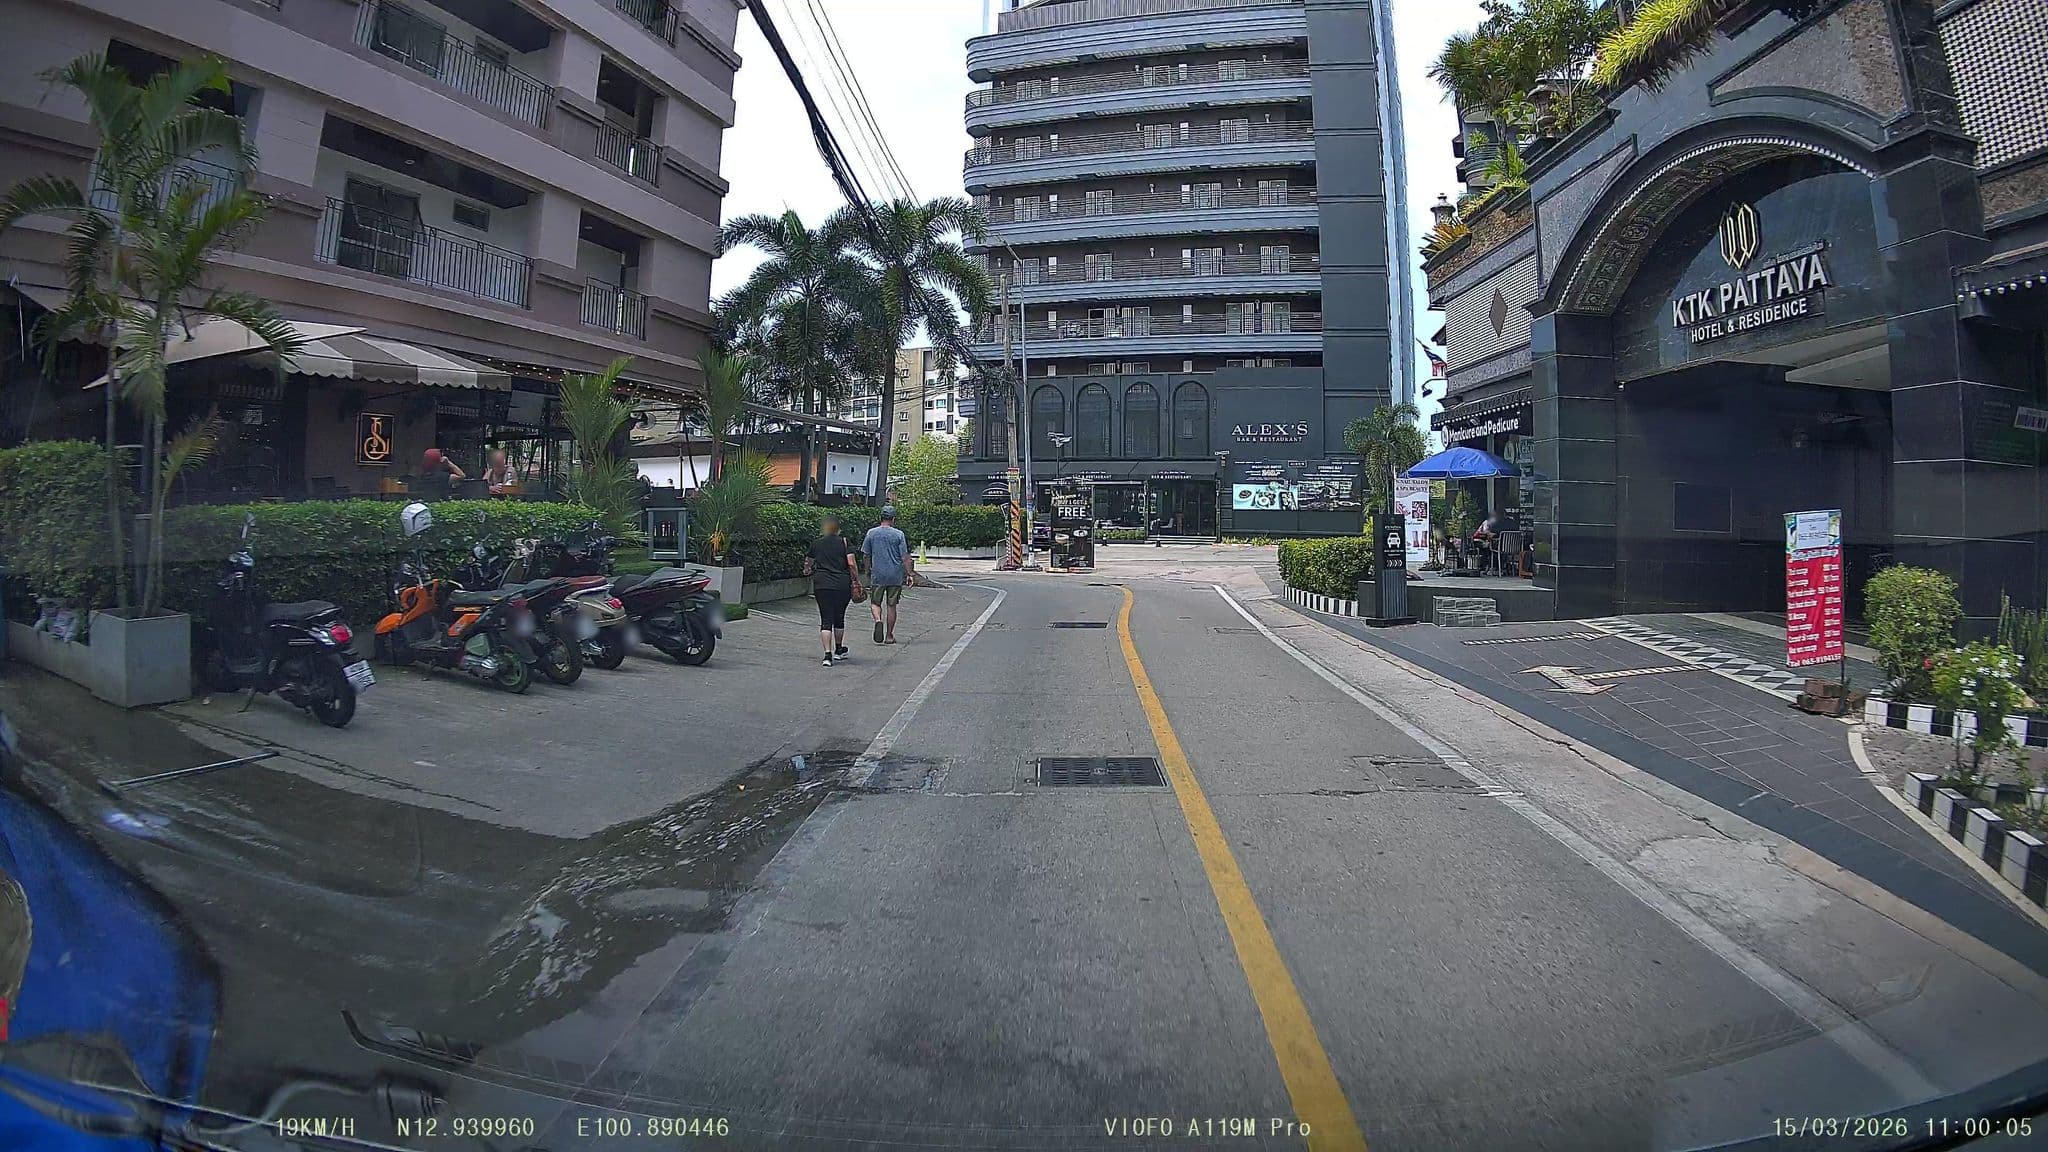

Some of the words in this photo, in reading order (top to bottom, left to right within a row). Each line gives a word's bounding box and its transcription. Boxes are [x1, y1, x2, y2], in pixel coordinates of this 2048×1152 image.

[1672, 288, 1713, 327] KTK
[1719, 254, 1828, 313] PATTAYA
[1691, 323, 1724, 343] HOTEL
[1727, 319, 1735, 333] &
[1738, 297, 1808, 330] RESIDENCE
[1231, 423, 1308, 436] ALEX'S
[1449, 427, 1475, 443] Manicure
[1475, 420, 1488, 437] and
[1487, 417, 1519, 435] Pedicure
[1058, 506, 1087, 517] FREE
